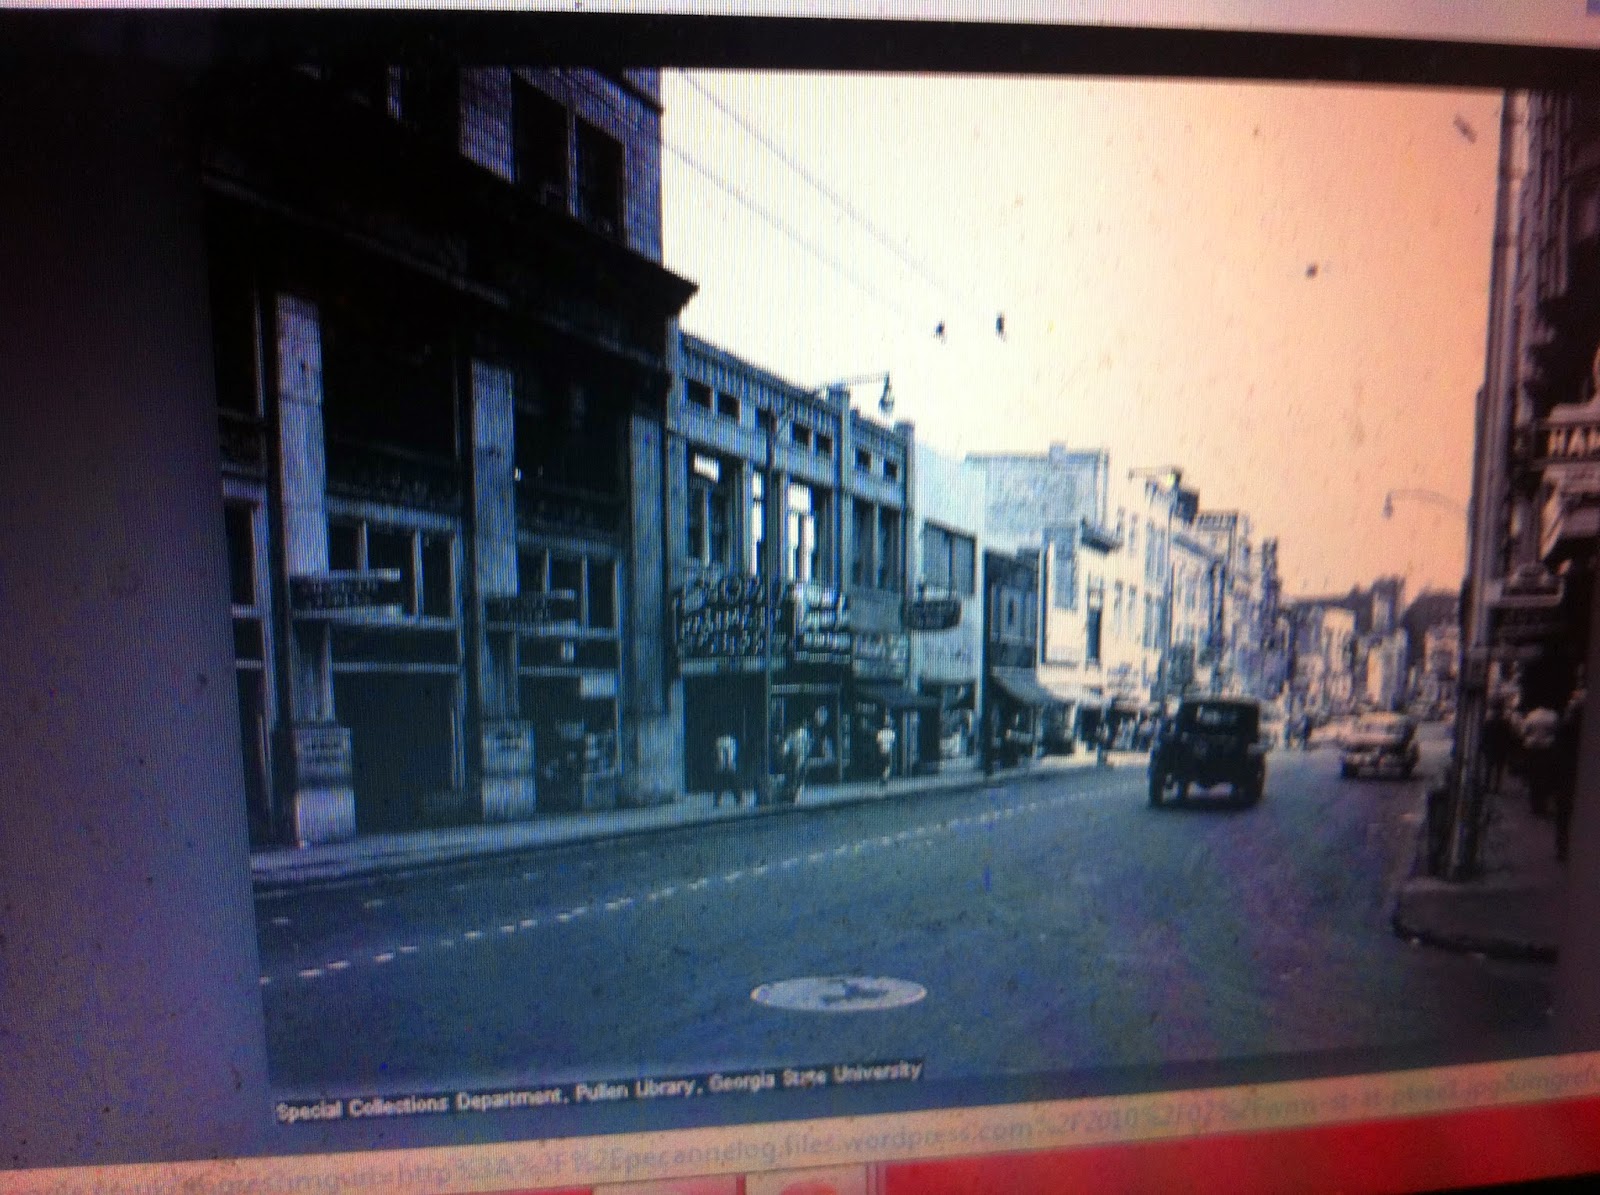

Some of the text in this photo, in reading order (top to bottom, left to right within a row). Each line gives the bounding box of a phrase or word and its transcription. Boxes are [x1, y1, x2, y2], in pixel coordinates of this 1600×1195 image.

[276, 1100, 342, 1123] Special
[349, 1095, 449, 1117] Collections
[575, 1082, 629, 1102] Pullen
[708, 1070, 776, 1093] Georgia
[782, 1067, 827, 1087] State
[833, 1059, 923, 1083] University
